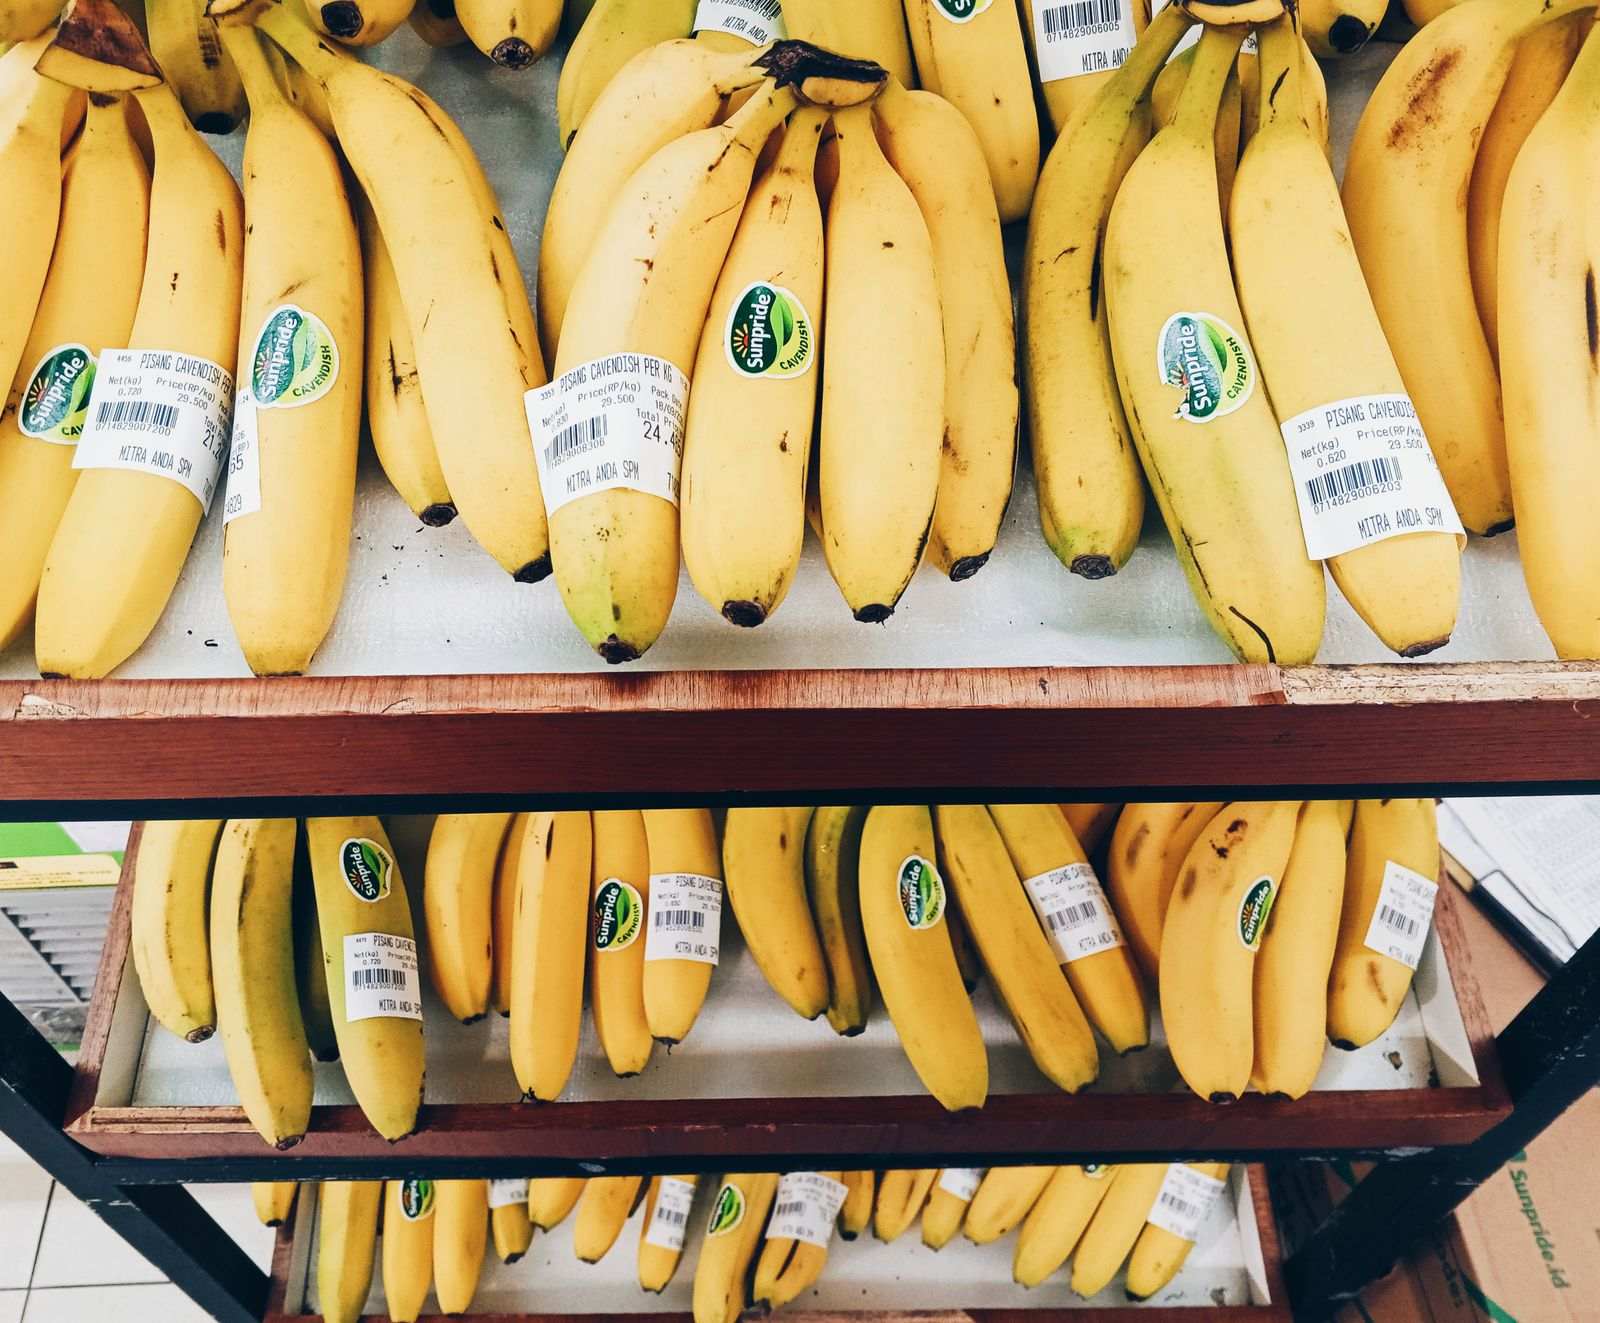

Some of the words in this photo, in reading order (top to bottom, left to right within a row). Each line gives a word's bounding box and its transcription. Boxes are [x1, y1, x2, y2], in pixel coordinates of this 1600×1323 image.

[722, 16, 748, 31] MITRA
[747, 25, 768, 43] ANDA
[1046, 23, 1120, 43] 0714829006005
[1082, 50, 1108, 72] MITRA
[746, 294, 771, 368] Sunpride
[780, 320, 809, 369] CAVENDISH
[140, 353, 173, 370] PISANG
[175, 357, 221, 386] CAVENDISH
[261, 318, 298, 398] Sunpride
[292, 345, 332, 397] CAVENDISH
[560, 367, 587, 393] PISANG
[591, 355, 640, 380] CAVENDISH
[643, 357, 660, 378] PER
[663, 362, 673, 383] KG
[1177, 323, 1212, 410] Sunpride
[1226, 337, 1247, 399] CAVENDISH
[29, 356, 84, 428] Sunpride
[108, 376, 142, 386] Net(kg)
[156, 377, 216, 402] Price(RP/kg)
[177, 392, 208, 410] 29.500
[601, 394, 635, 408] 29.500
[95, 421, 171, 436] 0714829007200
[636, 408, 660, 423] Total
[1325, 403, 1365, 429] PISANG
[119, 445, 147, 463] MITRA
[151, 449, 174, 471] ANDA
[177, 457, 193, 479] SPM
[1301, 437, 1340, 460] Net(kg)
[1317, 449, 1346, 468] 0.620
[1388, 439, 1423, 450] 29.500
[566, 469, 592, 494] MITRA
[596, 461, 618, 482] ANDA
[622, 459, 640, 480] SPM
[1313, 480, 1402, 515] 0714829006203
[1358, 513, 1391, 540] MITRA
[1396, 507, 1423, 528] ANDA
[1425, 507, 1443, 527] SPM
[350, 846, 377, 896] Sunpride
[909, 865, 921, 922] Sunpride
[597, 887, 620, 944] Sunpride
[617, 903, 640, 943] CAVENDISH
[1245, 886, 1270, 941] Sunpride
[1510, 1168, 1571, 1289] Sunpride.id
